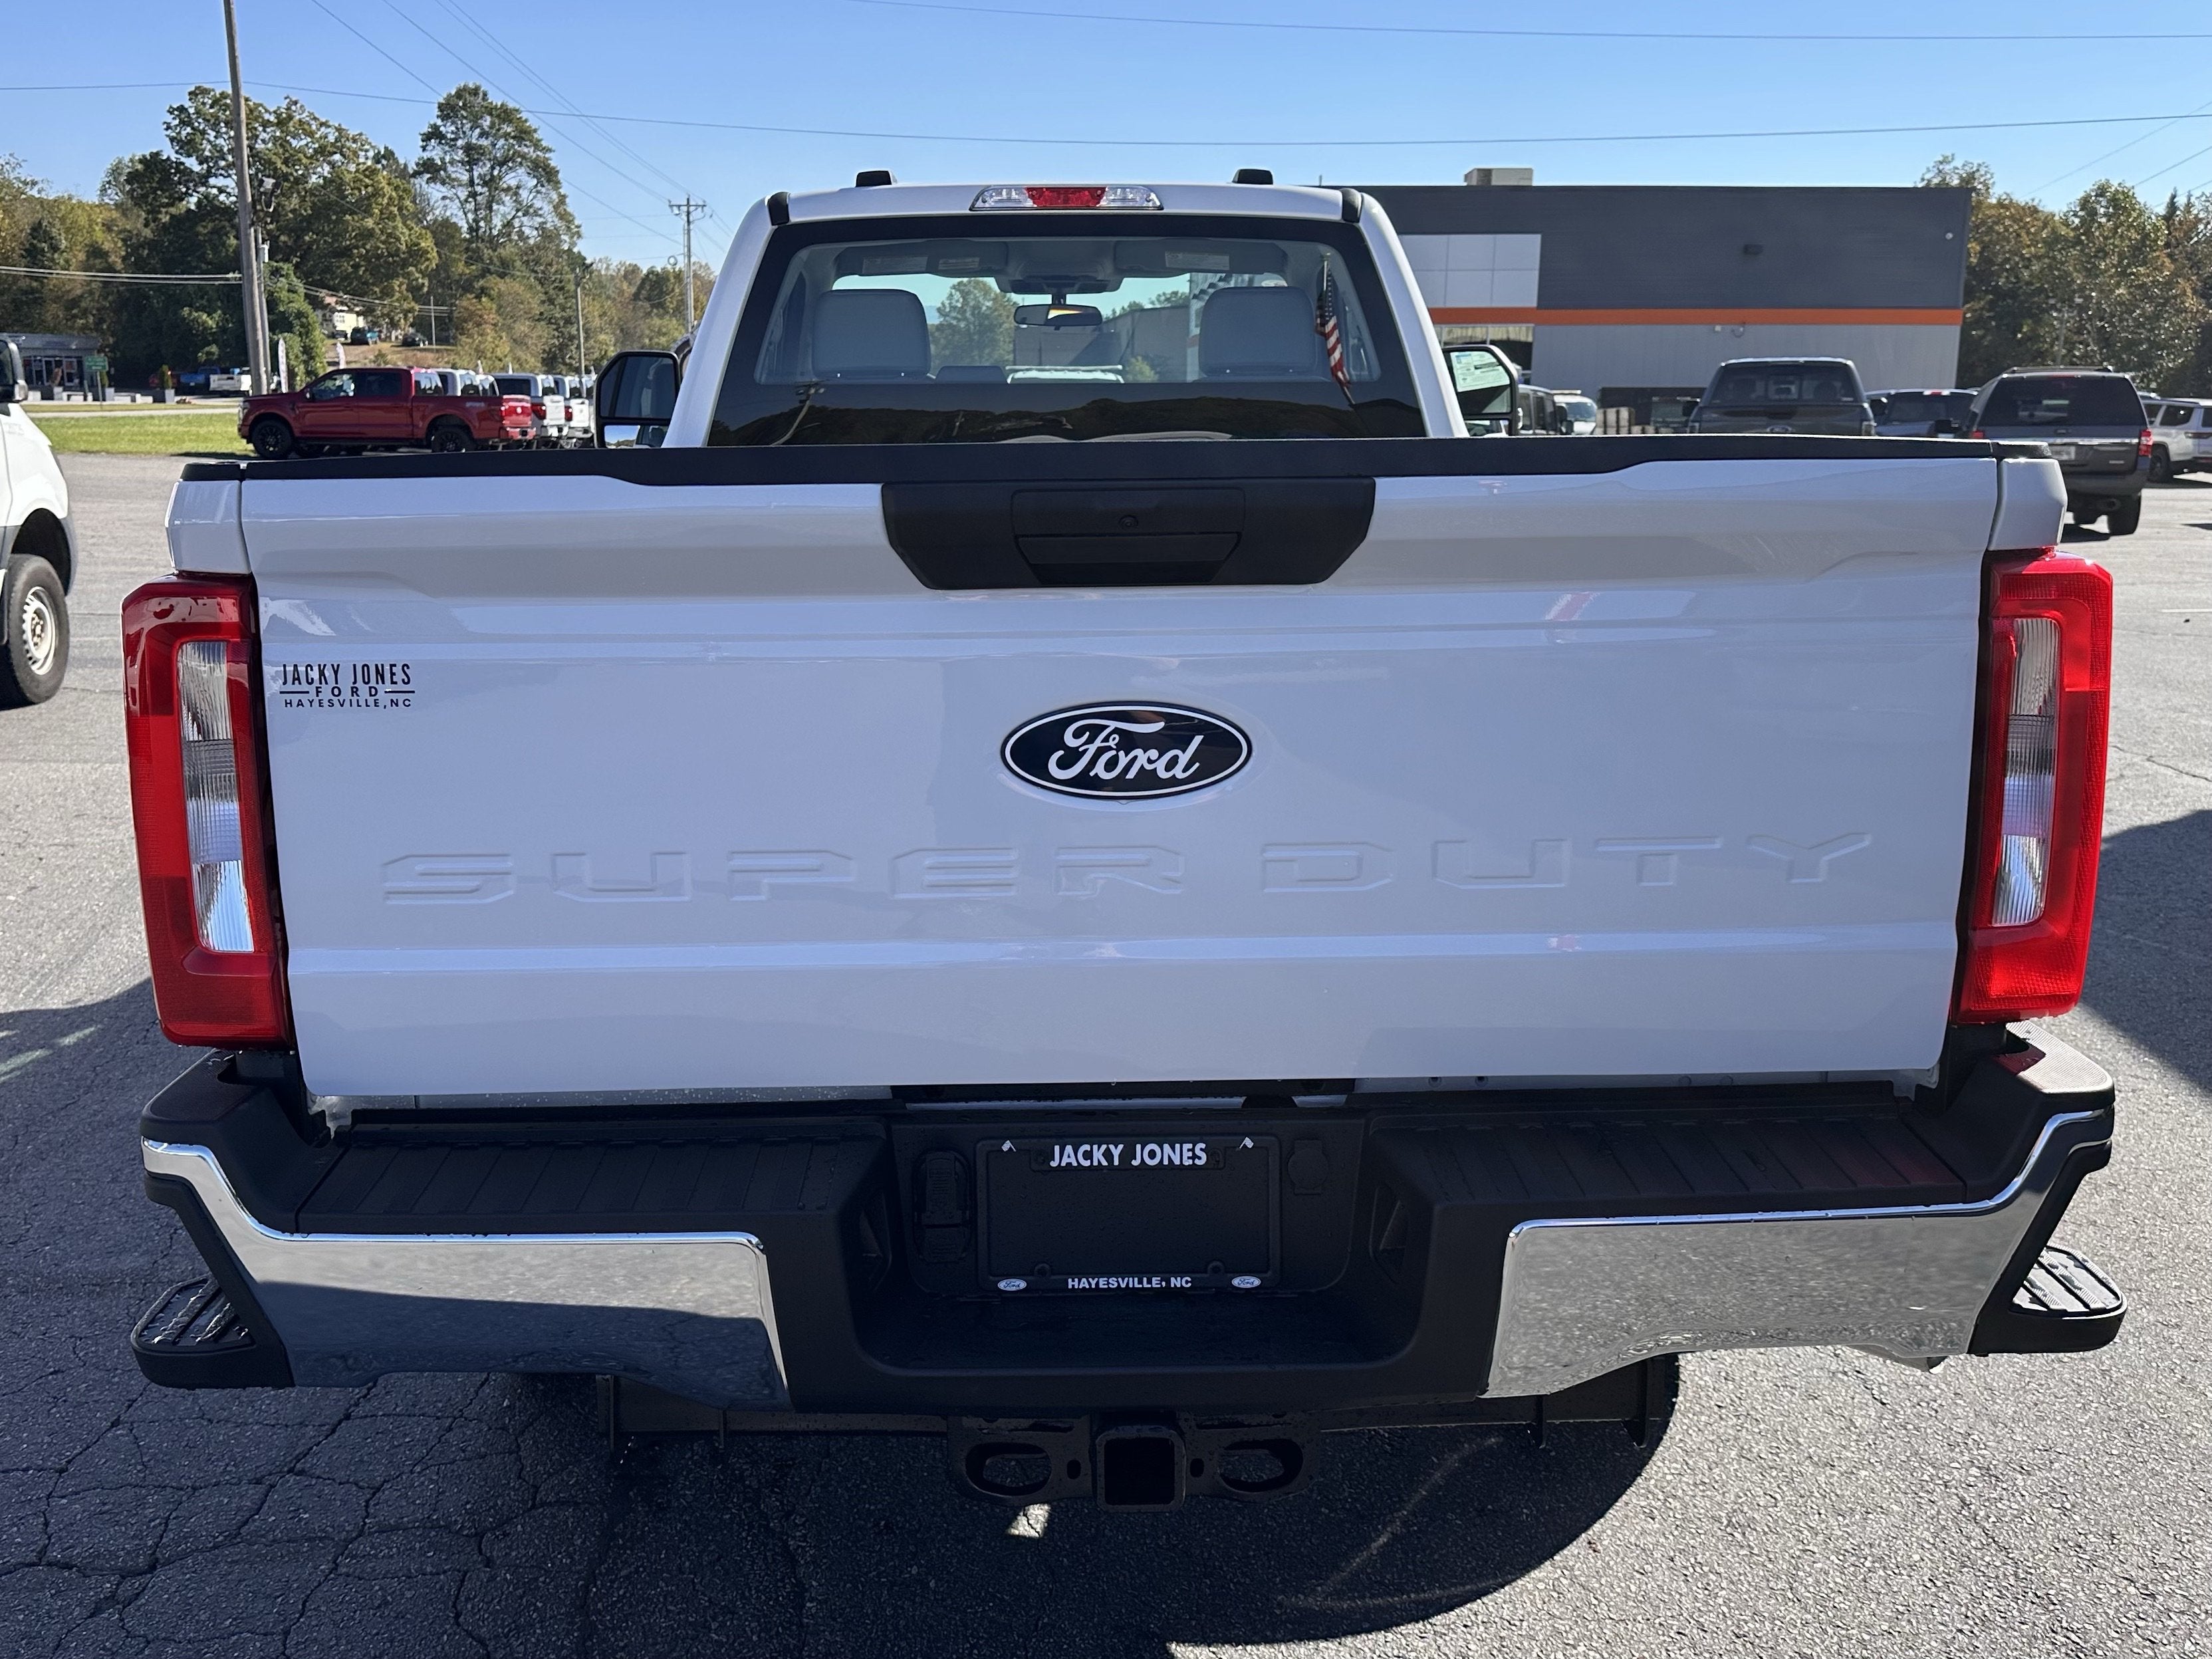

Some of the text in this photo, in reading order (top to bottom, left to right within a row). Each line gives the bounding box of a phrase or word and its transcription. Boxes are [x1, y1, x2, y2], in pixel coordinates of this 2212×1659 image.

[282, 663, 411, 686] JACKY JONES
[315, 686, 378, 698] FORD
[1047, 718, 1205, 781] Ford
[381, 832, 1873, 905] SUPER DUTY
[1049, 1142, 1207, 1168] JACKY JONES
[1067, 1276, 1192, 1289] HAYESVILLE, NC
